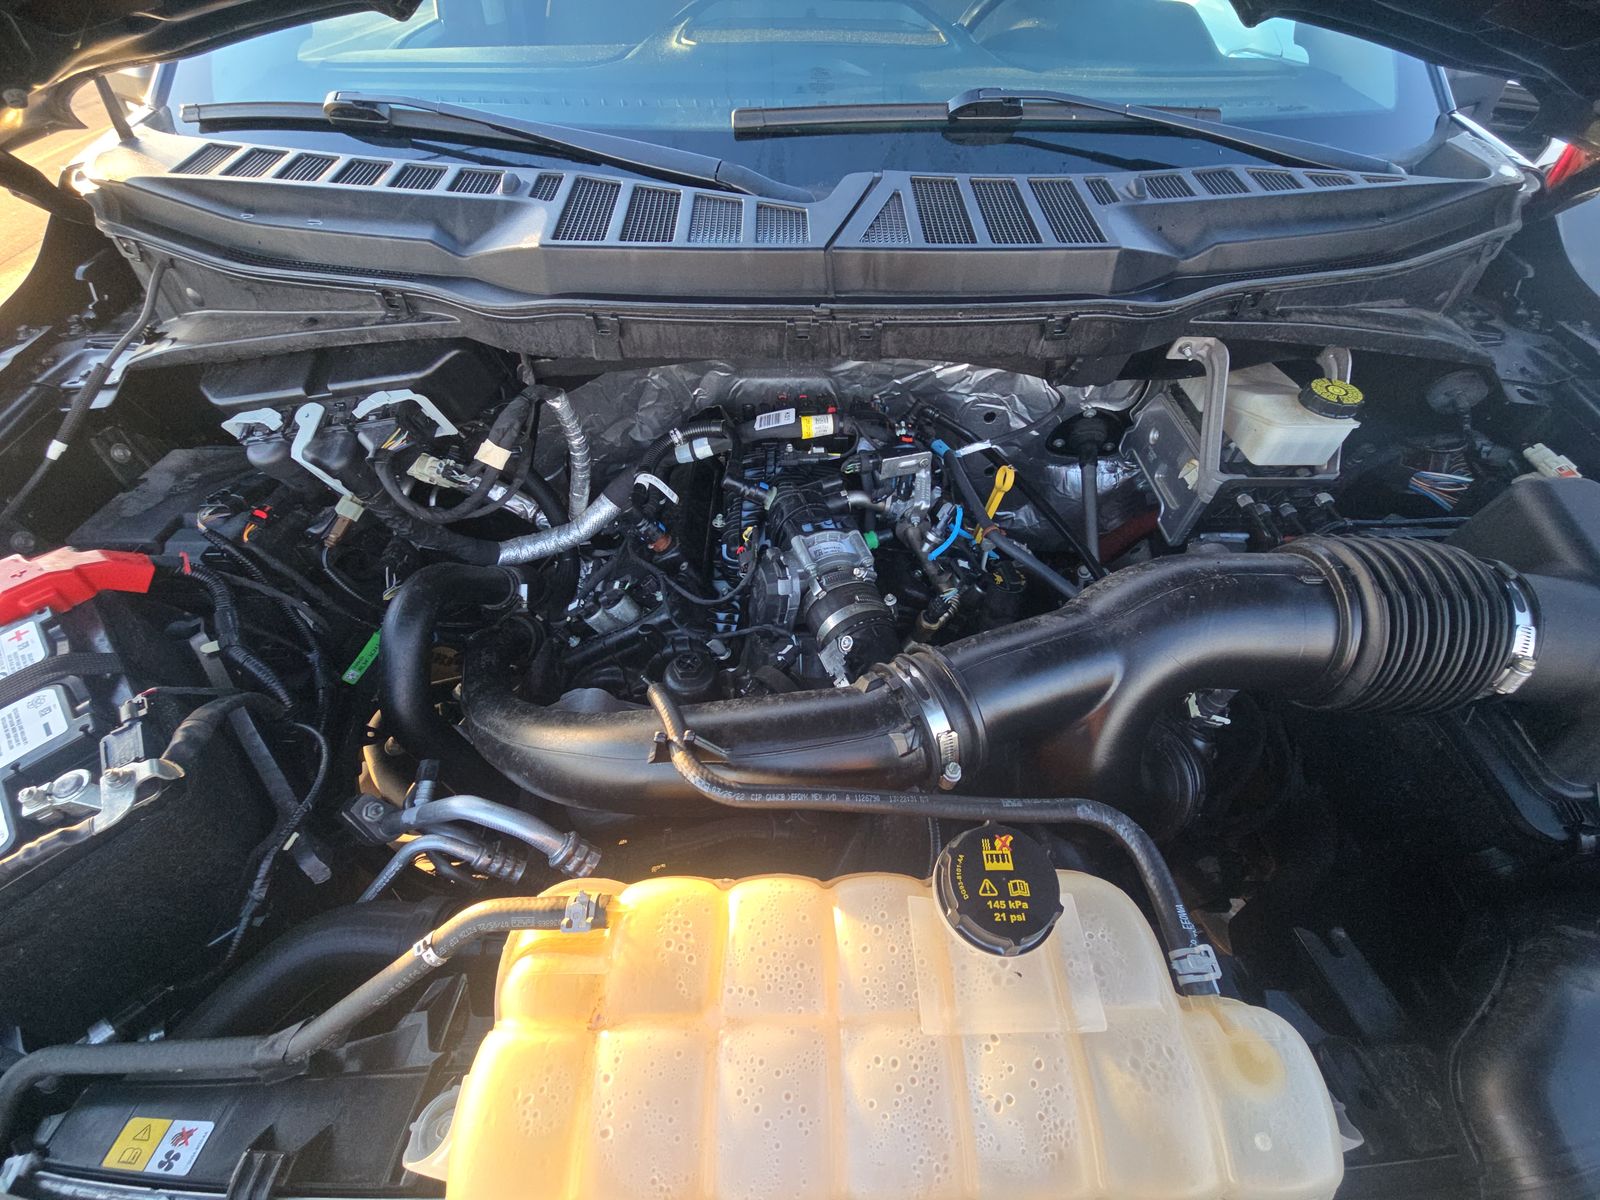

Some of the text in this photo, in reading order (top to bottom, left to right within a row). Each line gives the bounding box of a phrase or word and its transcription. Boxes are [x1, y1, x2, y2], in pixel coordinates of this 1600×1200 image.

[986, 900, 1029, 909] 145 kPa
[993, 912, 1026, 923] 21 psi
